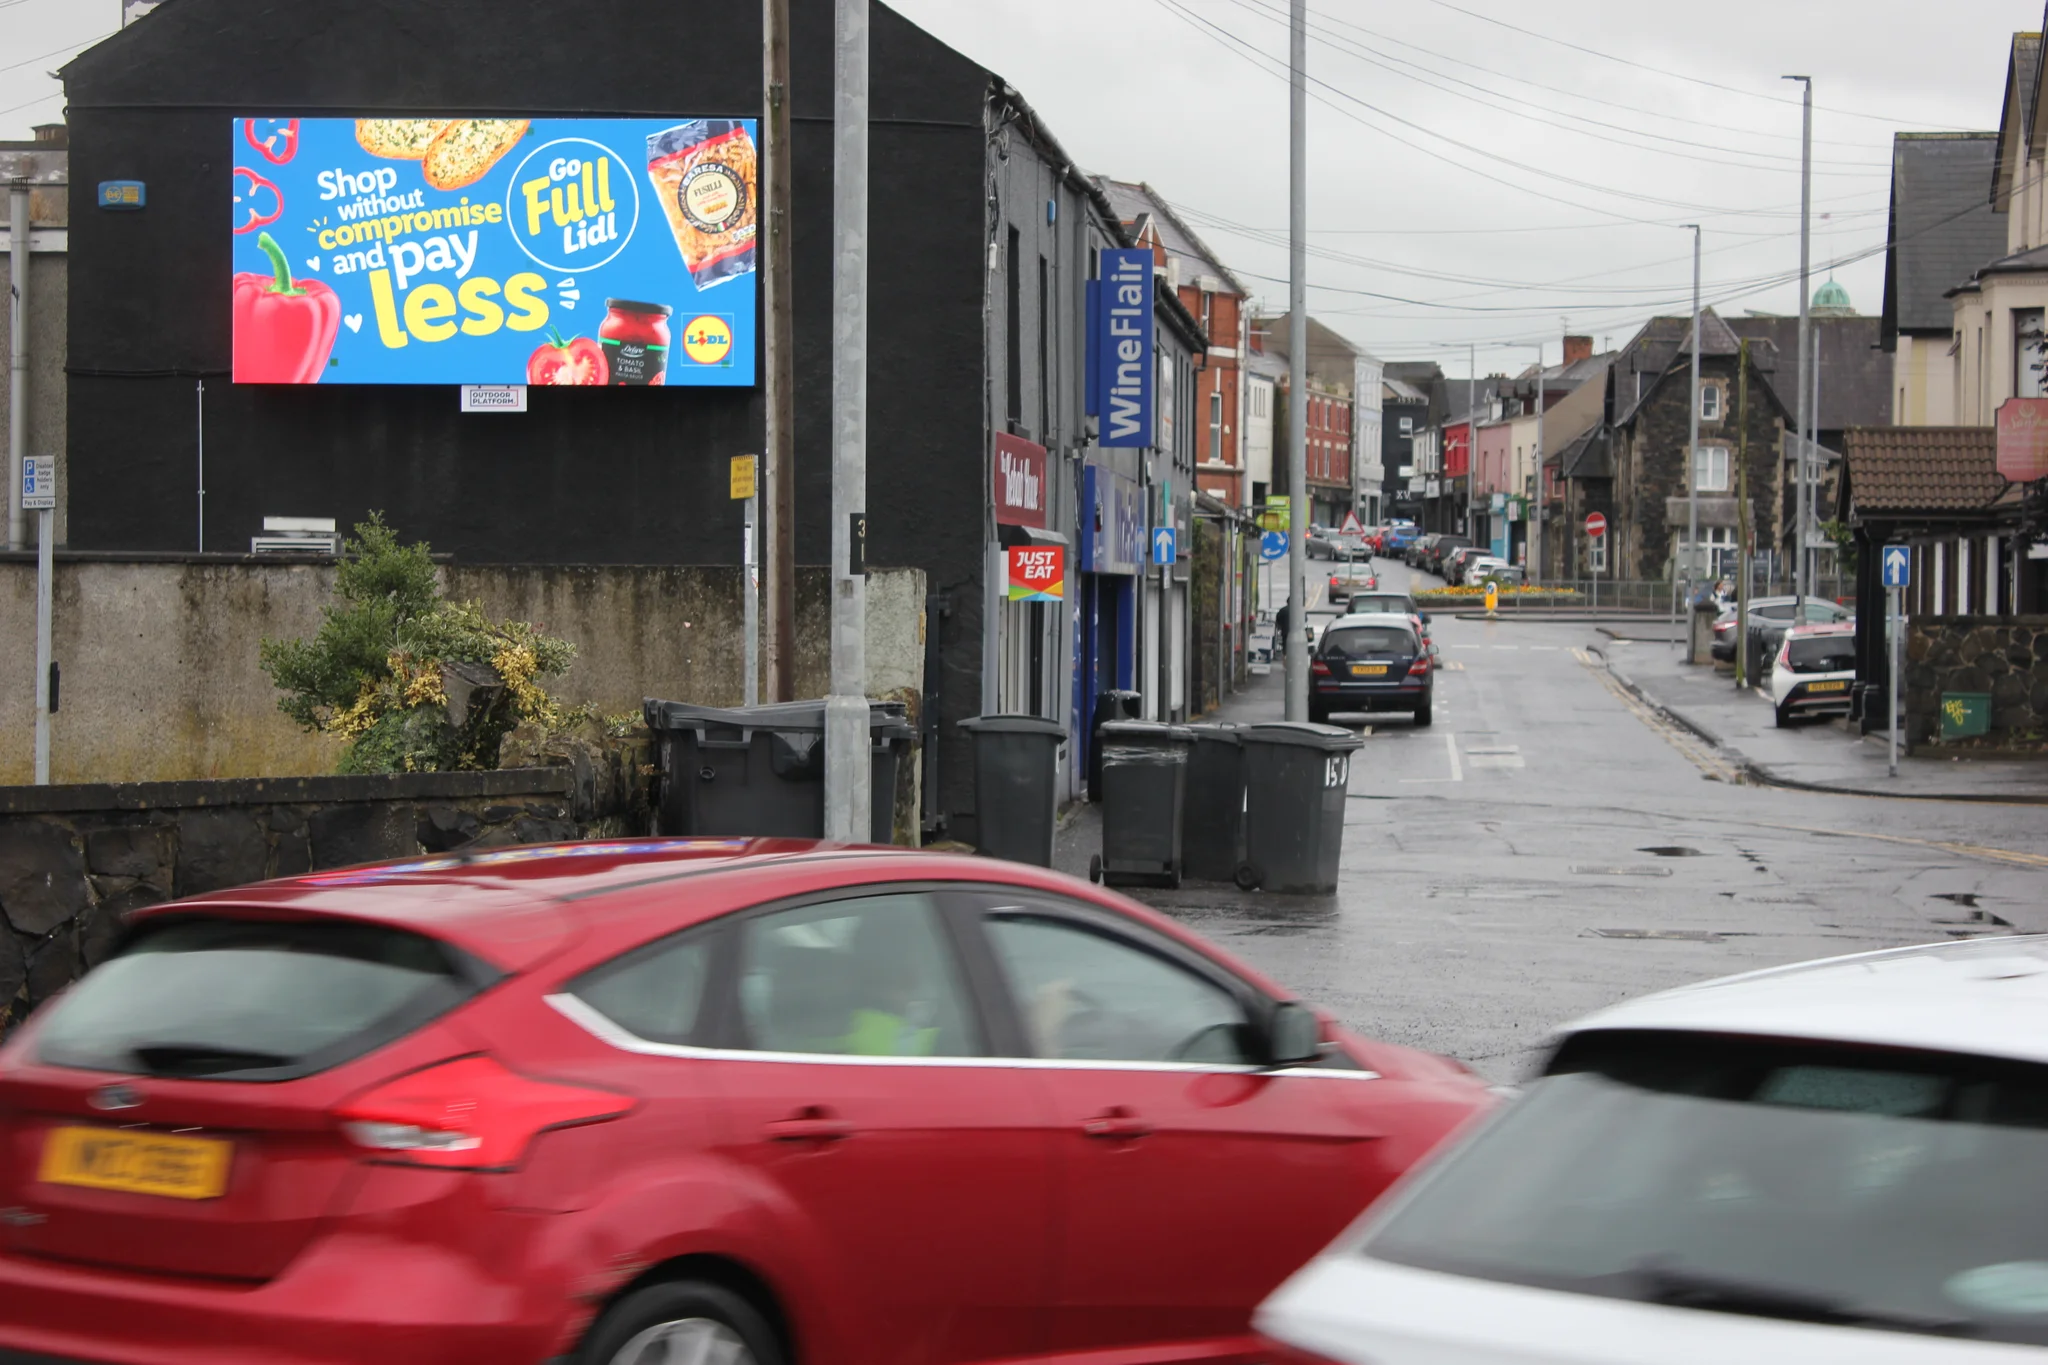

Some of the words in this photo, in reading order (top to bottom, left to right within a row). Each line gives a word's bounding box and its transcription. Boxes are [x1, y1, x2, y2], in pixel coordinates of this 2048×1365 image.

[317, 167, 397, 200] Shop
[549, 157, 581, 181] Go
[682, 164, 723, 186] BARESA
[337, 188, 425, 221] without
[522, 156, 615, 236] Full
[694, 180, 722, 197] FUSILLI
[318, 196, 502, 250] compromise
[564, 212, 618, 255] Lidl
[332, 241, 386, 275] and
[388, 230, 478, 290] pay
[369, 268, 549, 349] less
[617, 357, 645, 368] TOMATO
[1110, 256, 1142, 439] WineFlair
[624, 365, 642, 375] BASIL
[1016, 551, 1056, 567] JUST
[1024, 565, 1056, 579] EAT
